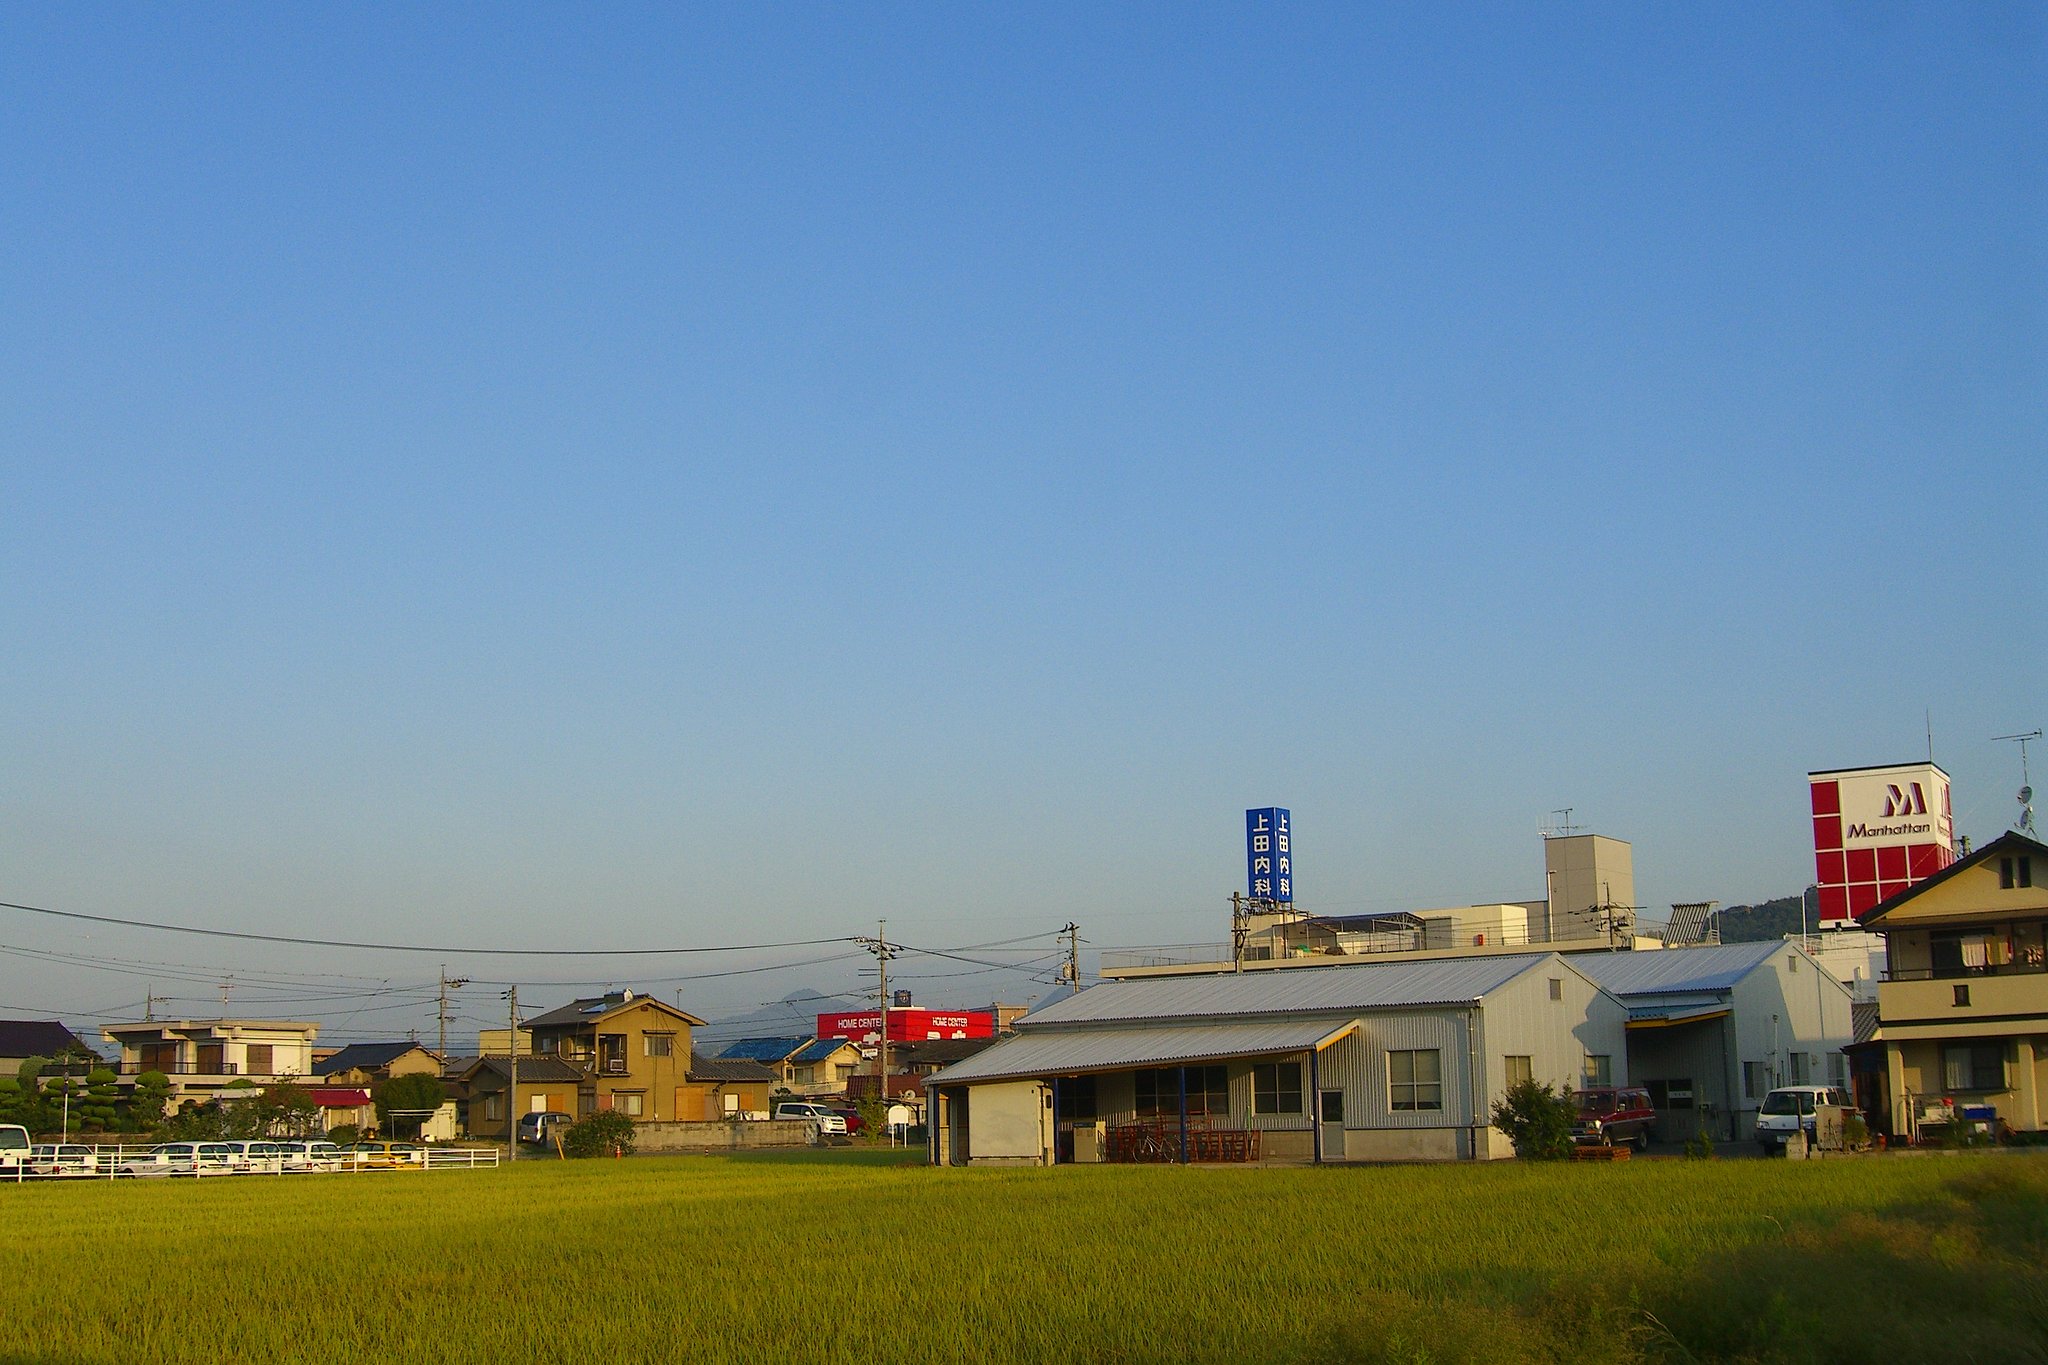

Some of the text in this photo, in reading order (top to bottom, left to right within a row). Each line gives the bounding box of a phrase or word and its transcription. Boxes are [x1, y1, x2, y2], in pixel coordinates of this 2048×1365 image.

[1848, 823, 1930, 839] Manhattan
[1253, 814, 1271, 896] 上田内科
[1279, 814, 1290, 896] 上田内科
[838, 1018, 883, 1028] HOME CENTE
[932, 1017, 968, 1027] HOME CENTER
